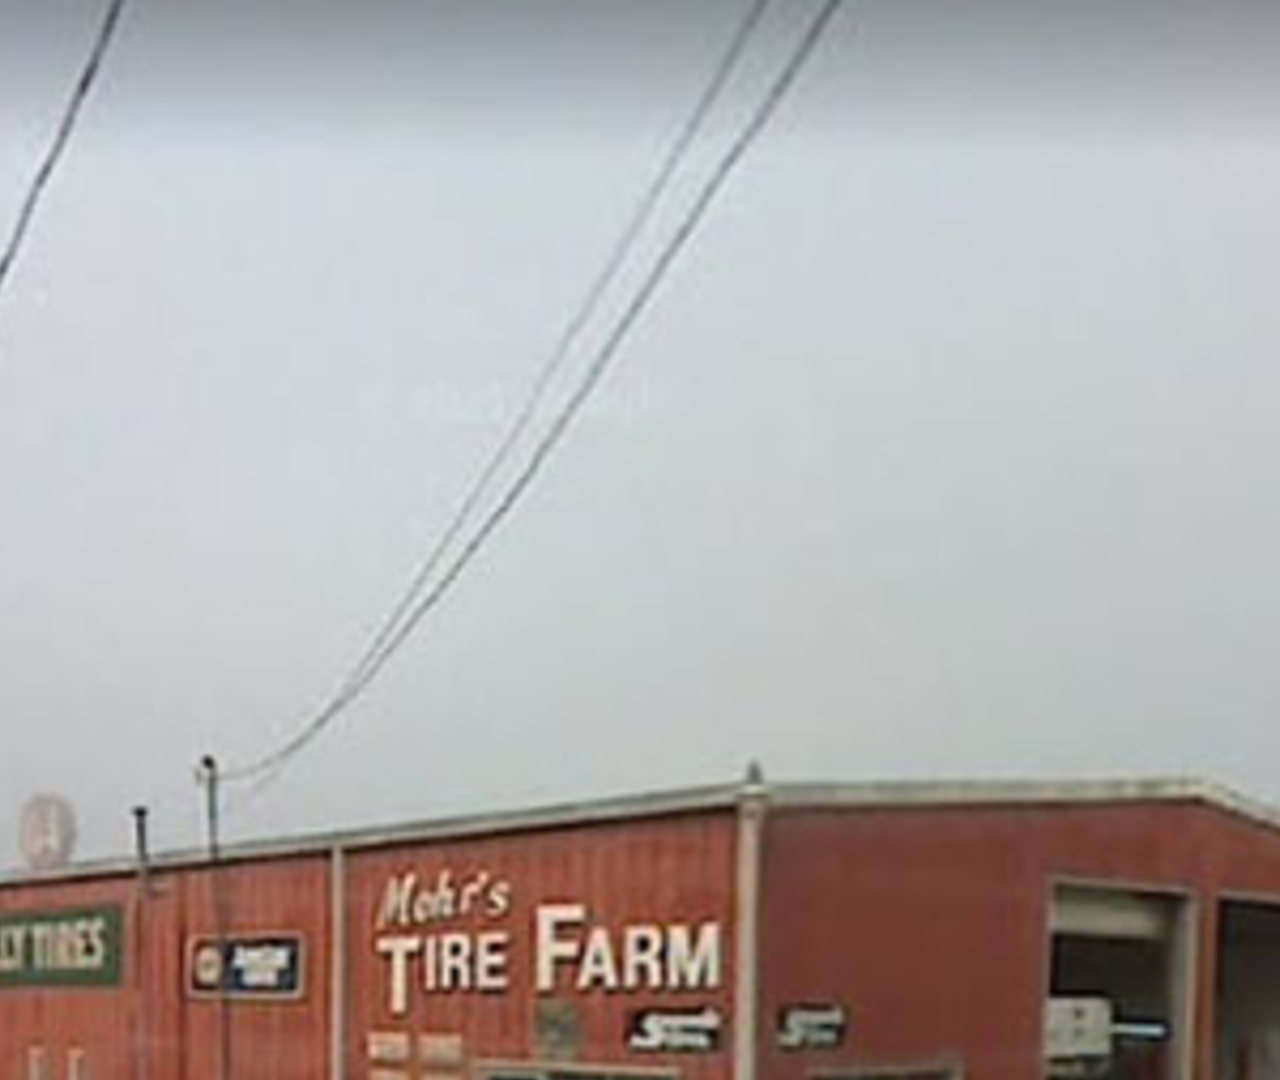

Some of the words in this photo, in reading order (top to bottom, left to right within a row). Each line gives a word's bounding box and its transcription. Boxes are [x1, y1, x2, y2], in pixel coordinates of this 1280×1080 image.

[32, 915, 105, 970] TIRES
[376, 932, 510, 1014] TIRE
[535, 903, 719, 990] FARM
